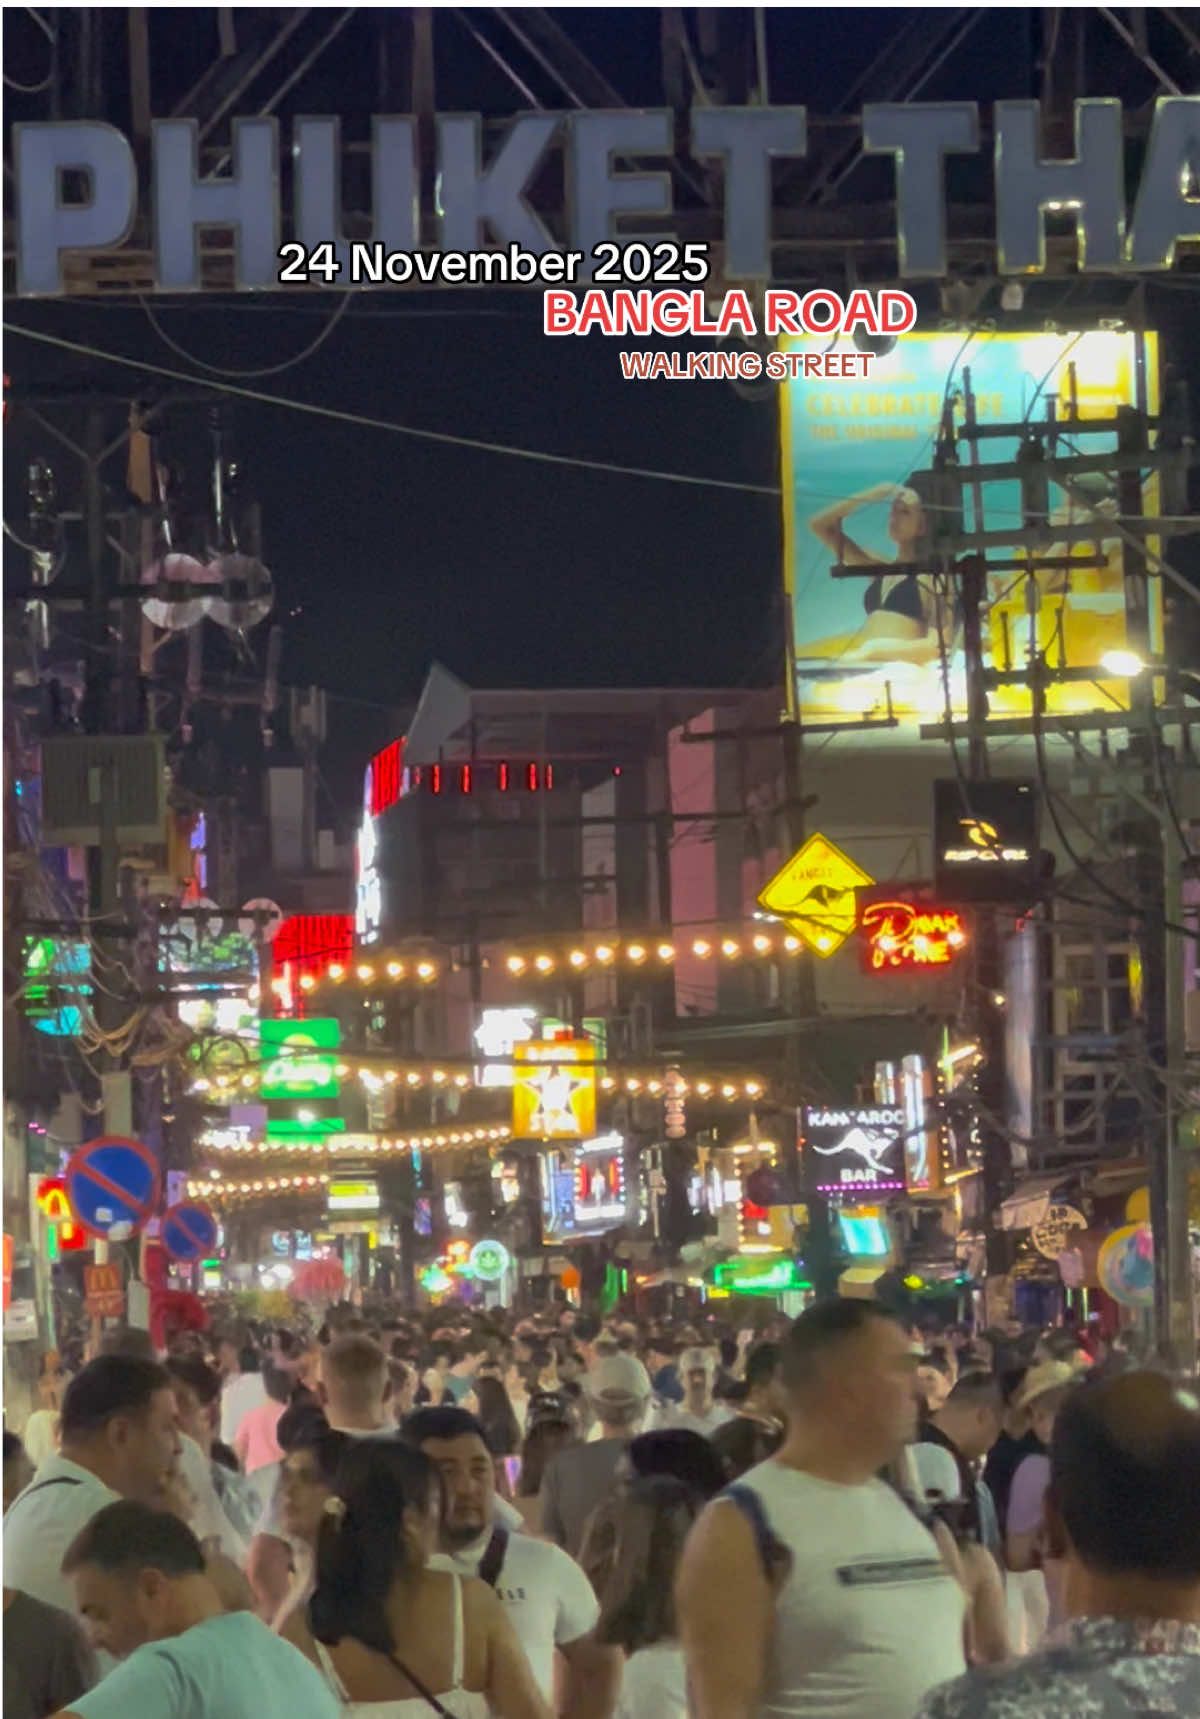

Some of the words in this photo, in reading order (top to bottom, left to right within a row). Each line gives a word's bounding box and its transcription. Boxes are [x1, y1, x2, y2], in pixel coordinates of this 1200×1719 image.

[13, 106, 807, 296] PHUKET
[807, 1110, 904, 1128] KANAROO
[841, 1168, 878, 1183] BAR
